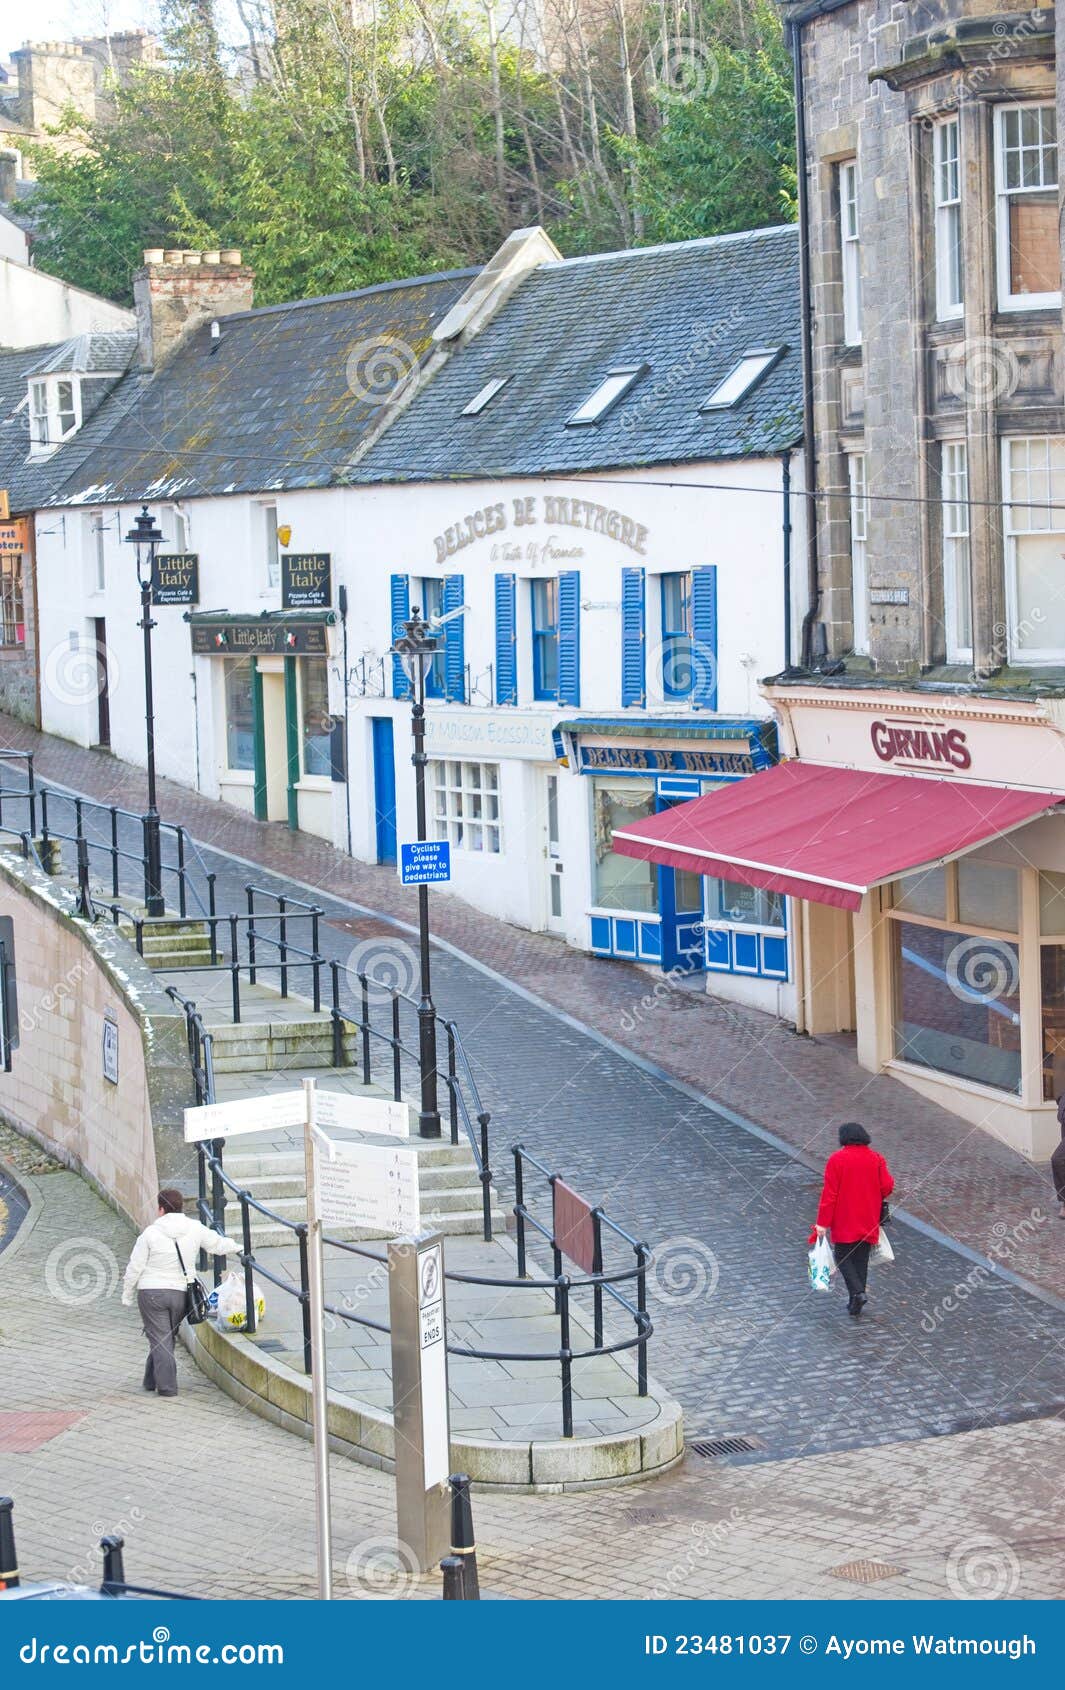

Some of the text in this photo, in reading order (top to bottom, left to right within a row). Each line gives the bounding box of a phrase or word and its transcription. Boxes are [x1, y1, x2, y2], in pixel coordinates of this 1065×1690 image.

[433, 495, 649, 564] DELICES DE BRETAGNE
[540, 535, 585, 564] France
[158, 556, 193, 570] Little
[288, 556, 326, 571] Little
[160, 571, 191, 588] Italy
[291, 572, 322, 591] Italy
[232, 628, 256, 646] Little
[256, 628, 277, 651] Italy
[870, 720, 972, 770] GIRVANS
[586, 748, 756, 773] DELICES DE BRETAGN
[410, 844, 441, 855] Cyclists
[413, 854, 438, 863] please
[405, 864, 420, 872] give
[422, 863, 437, 871] way
[404, 872, 448, 882] pedestrians
[424, 1326, 440, 1343] ENDS
